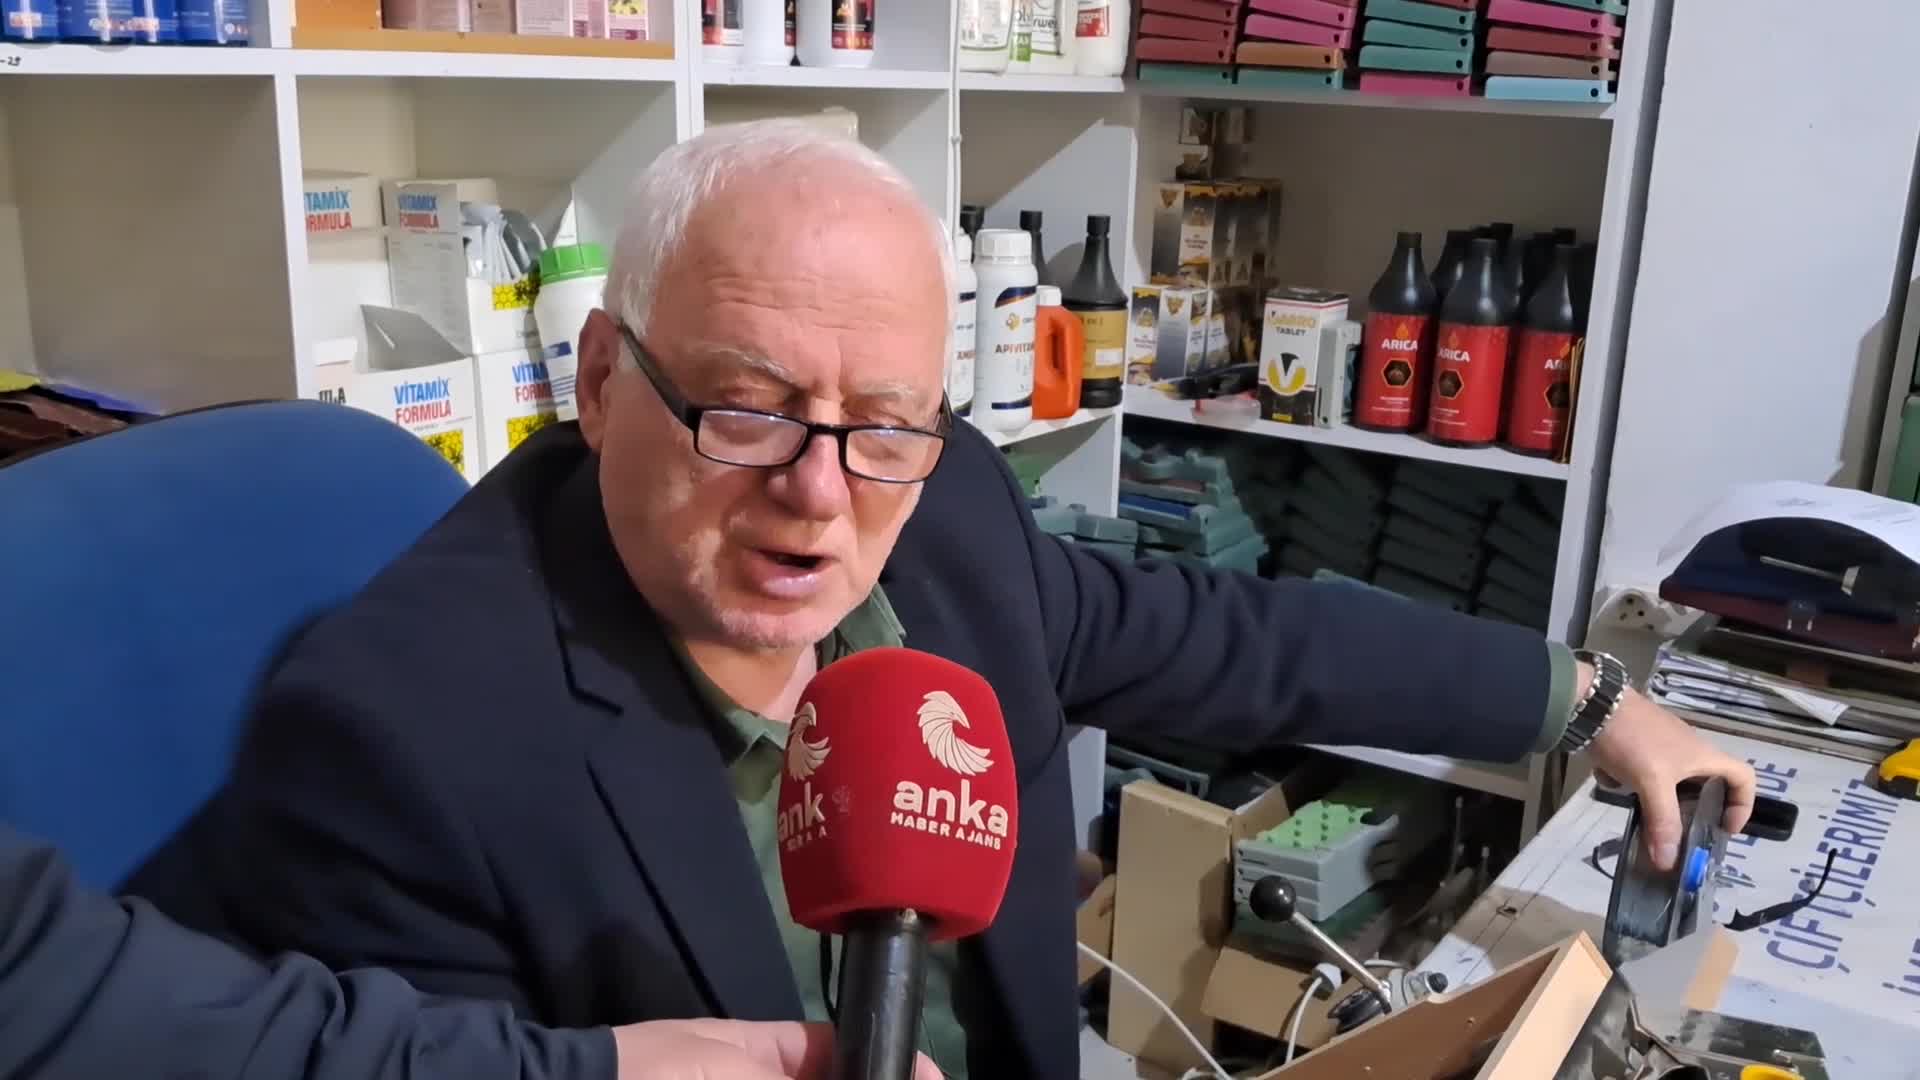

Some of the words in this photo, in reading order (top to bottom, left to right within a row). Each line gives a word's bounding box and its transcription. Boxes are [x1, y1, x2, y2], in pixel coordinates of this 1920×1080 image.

[304, 186, 350, 211] TAMİX
[308, 212, 352, 232] RMULA
[1381, 338, 1418, 351] ARICA
[512, 361, 548, 383] VİTAM
[394, 376, 450, 404] VİTAMİX
[394, 400, 452, 425] FORMULA
[893, 779, 1009, 837] anka
[890, 811, 951, 838] HABER
